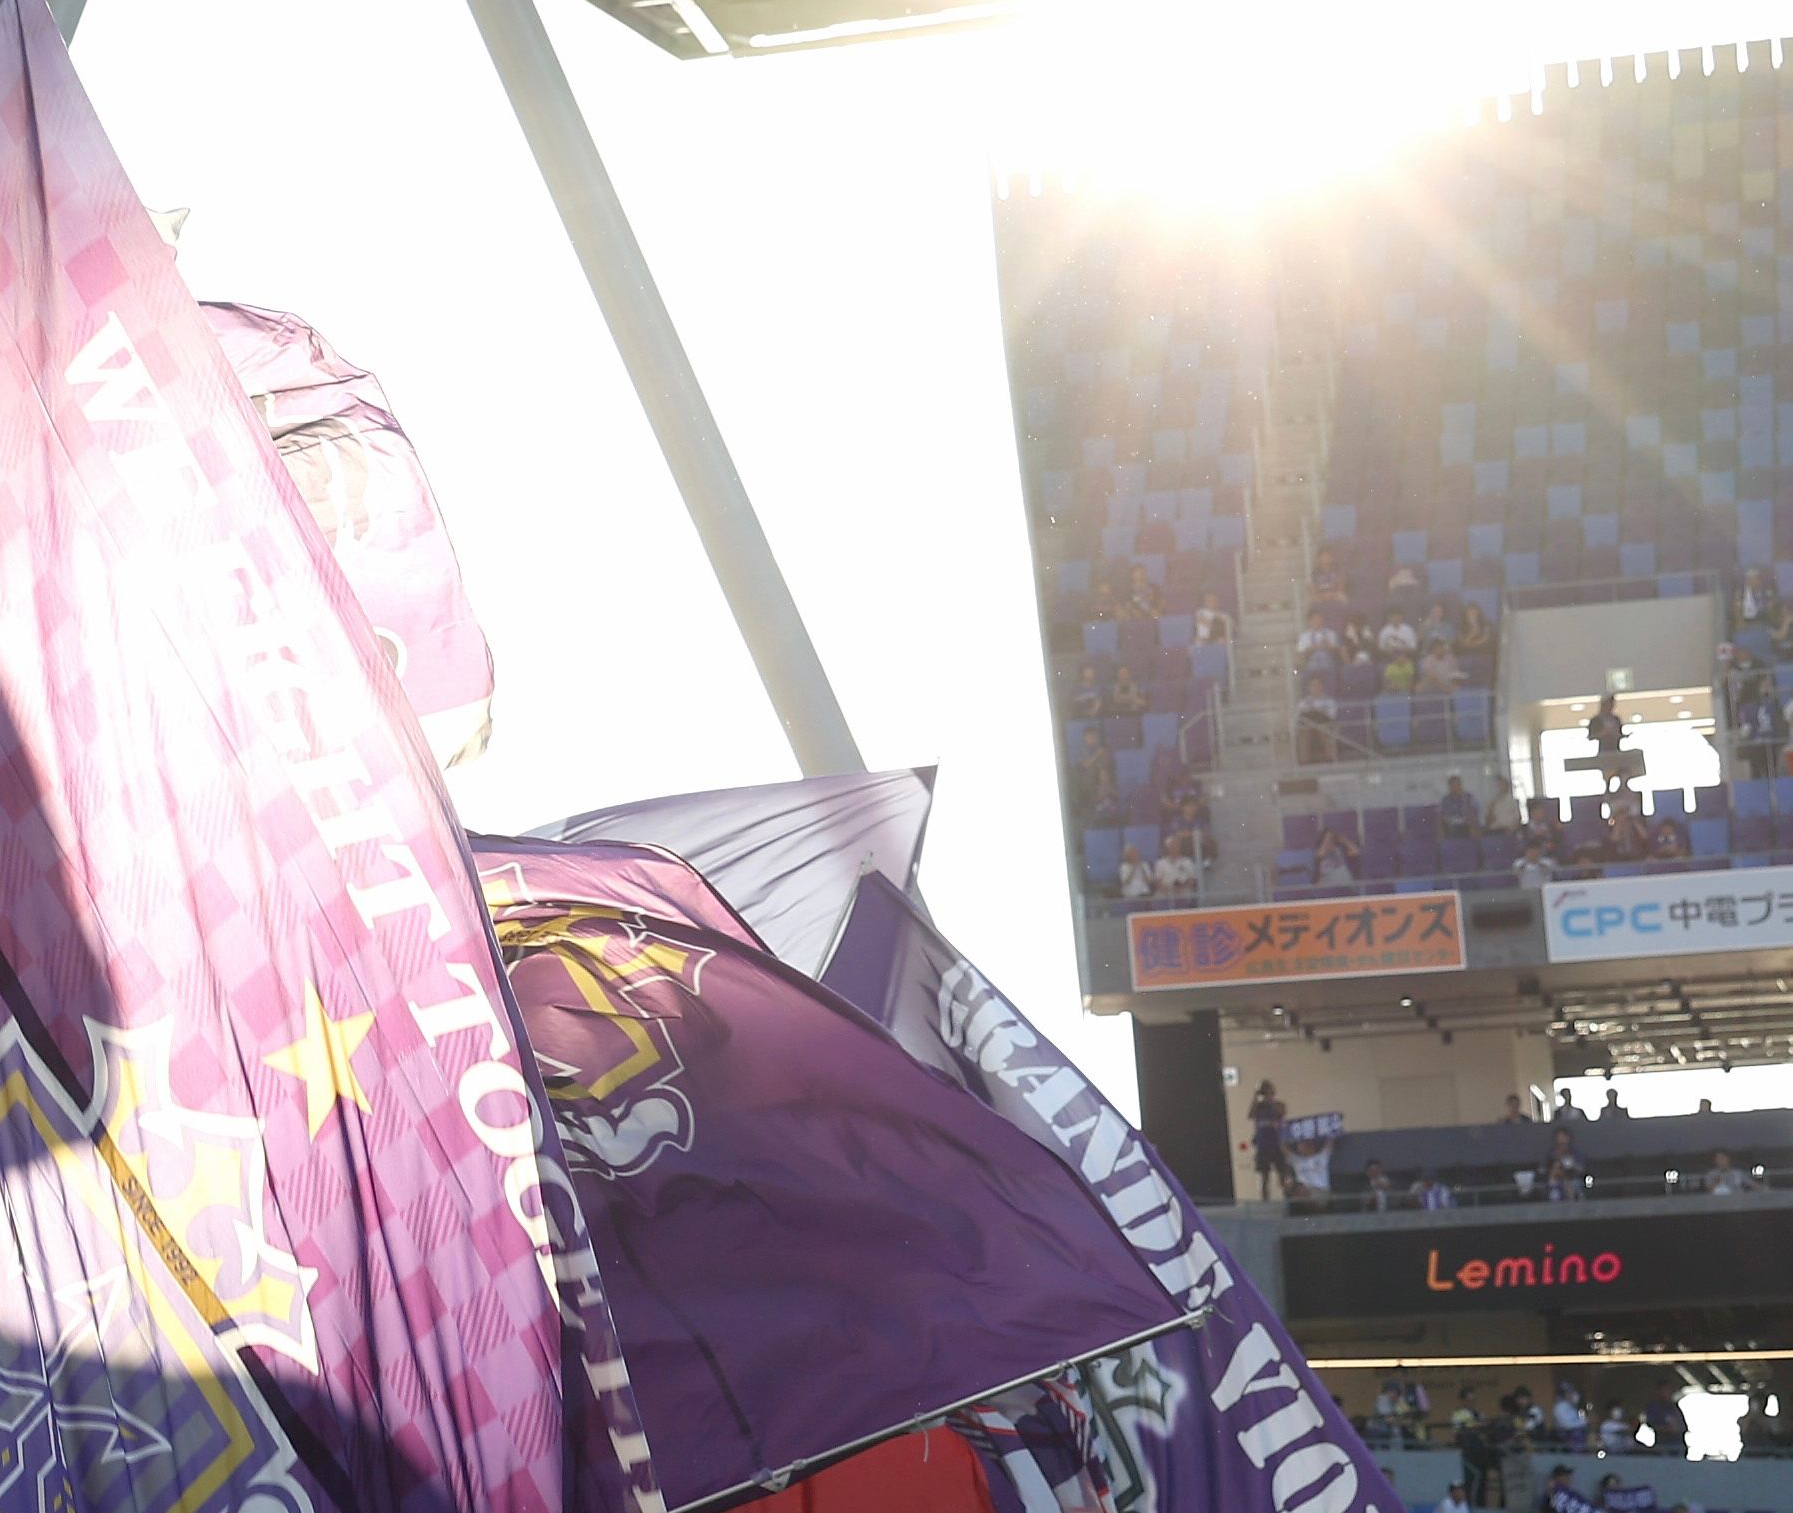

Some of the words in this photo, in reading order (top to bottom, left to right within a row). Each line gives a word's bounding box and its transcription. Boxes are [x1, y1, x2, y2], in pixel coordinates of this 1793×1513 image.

[1560, 902, 1664, 938] CPC
[1427, 1244, 1622, 1291] Lemino
[1211, 1322, 1380, 1513] VIO
